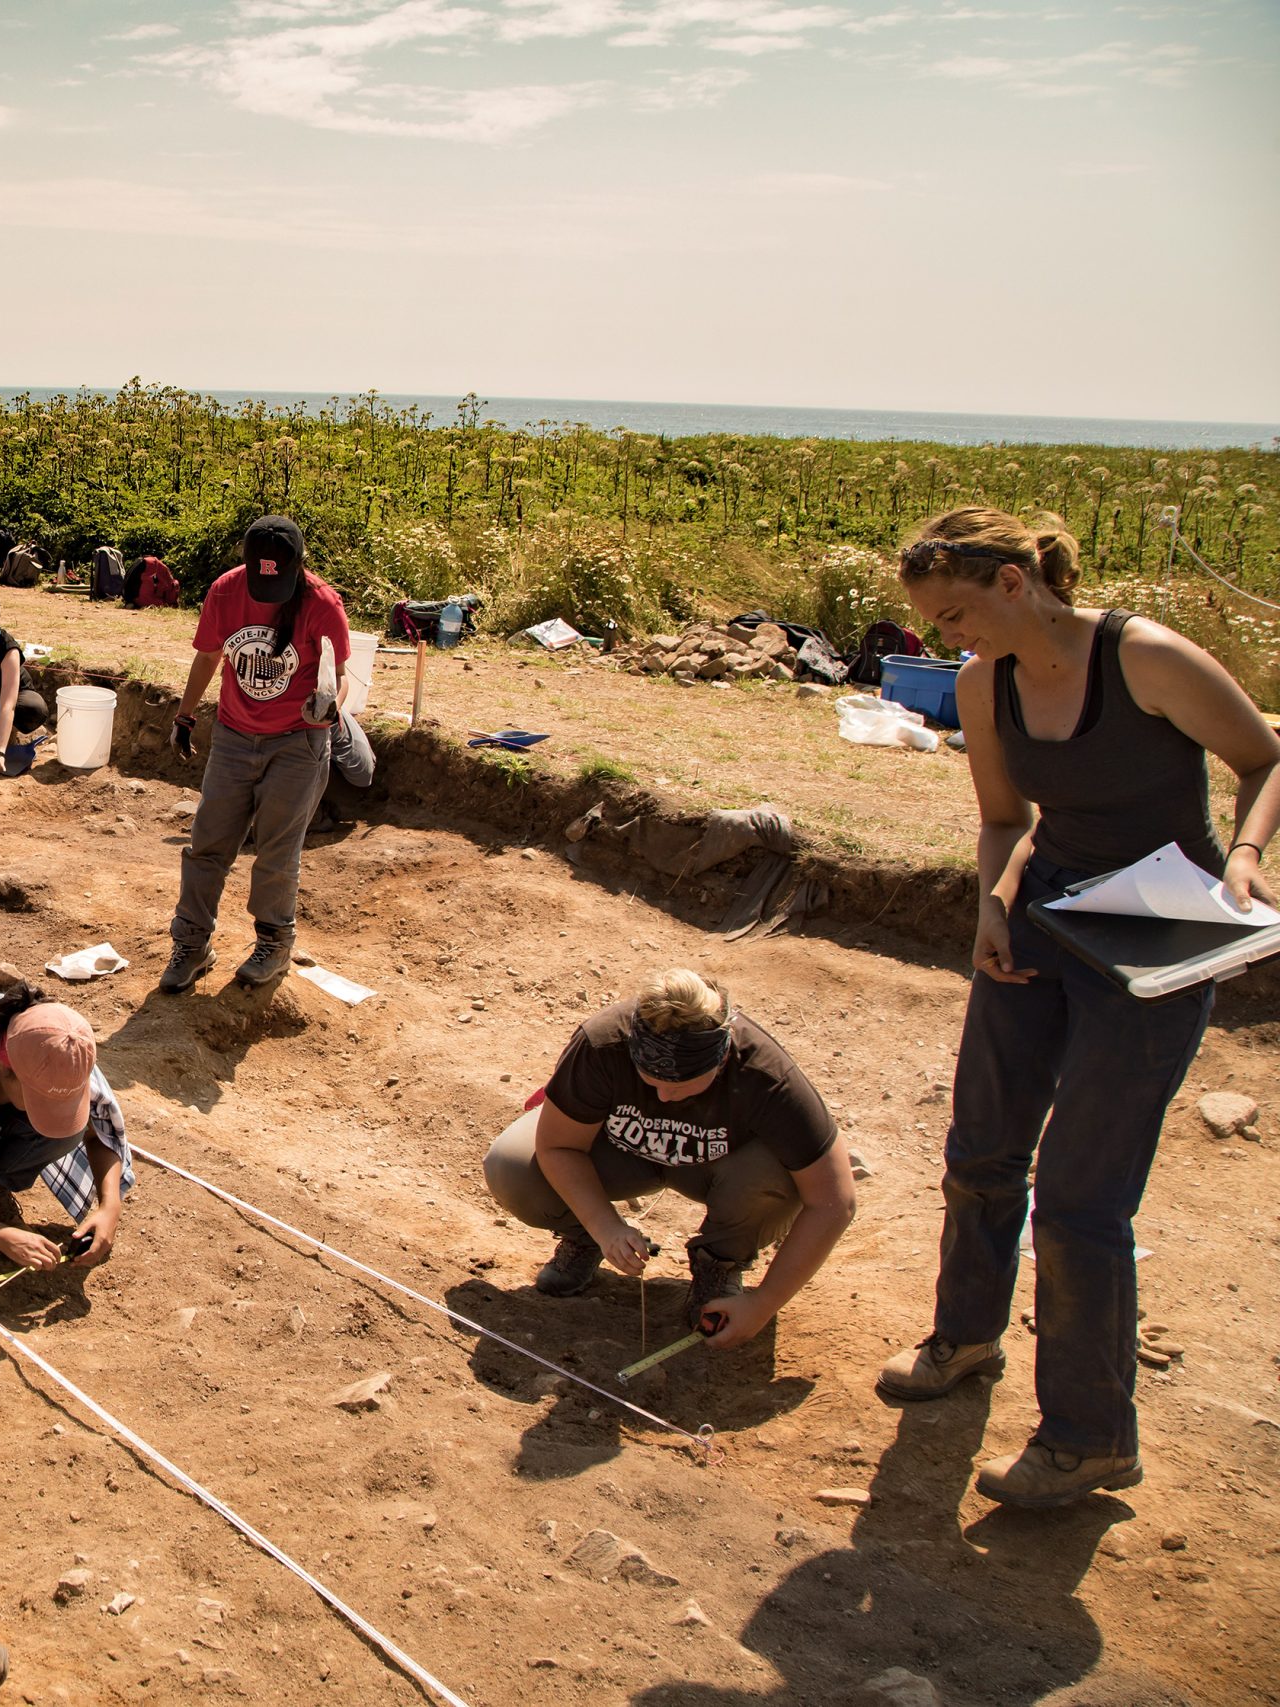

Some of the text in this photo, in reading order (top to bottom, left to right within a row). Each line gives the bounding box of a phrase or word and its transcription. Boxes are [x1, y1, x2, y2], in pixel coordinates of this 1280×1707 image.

[260, 559, 278, 575] R
[228, 630, 269, 650] MOVE-IN
[710, 1143, 726, 1154] 50
